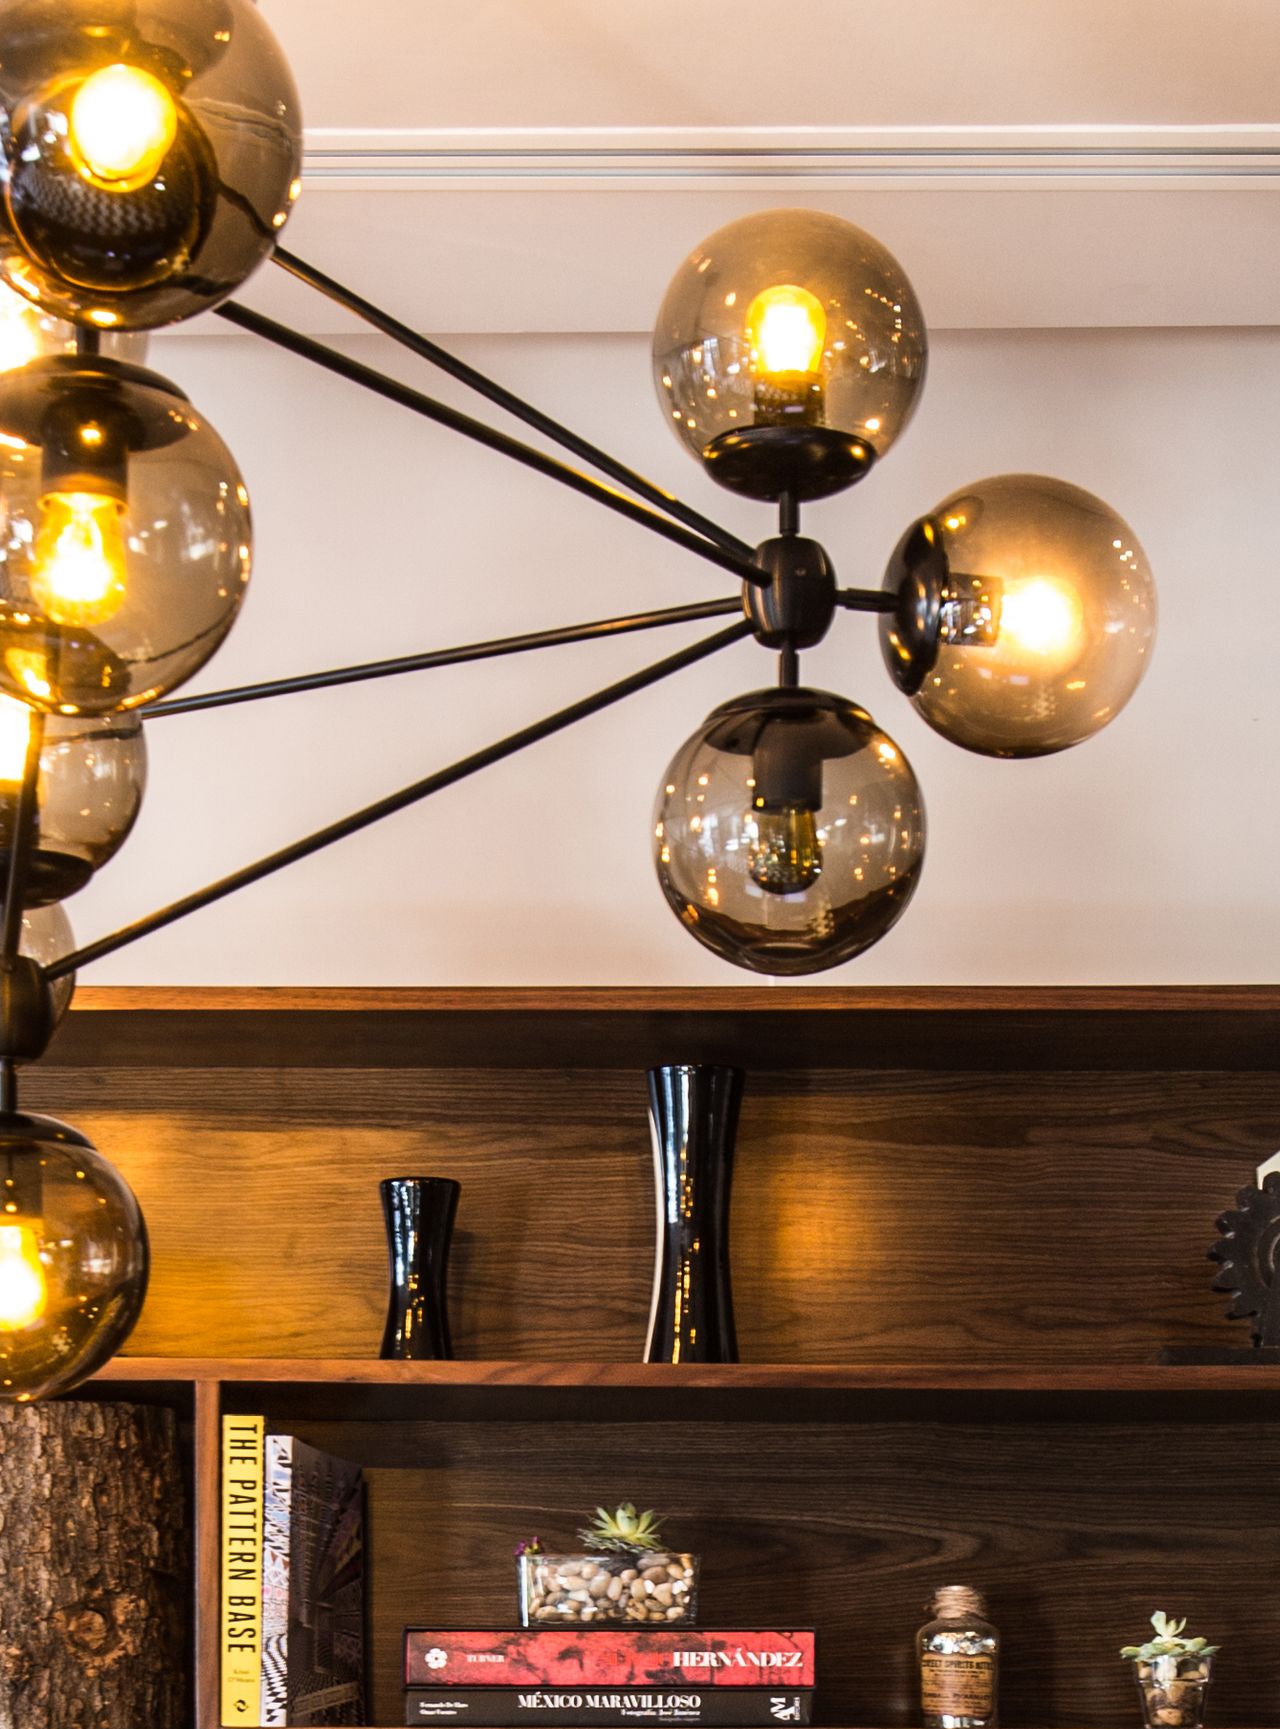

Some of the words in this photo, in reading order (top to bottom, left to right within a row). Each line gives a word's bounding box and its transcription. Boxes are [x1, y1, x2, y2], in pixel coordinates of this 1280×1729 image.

[229, 1424, 259, 1465] THE
[228, 1479, 258, 1581] PATTERN
[227, 1595, 257, 1654] BASE
[466, 1654, 505, 1663] TURNER
[672, 1647, 804, 1668] HERNÁNDEZ
[517, 1691, 583, 1709] MÉXICO
[584, 1694, 702, 1709] MARAVILLOSO
